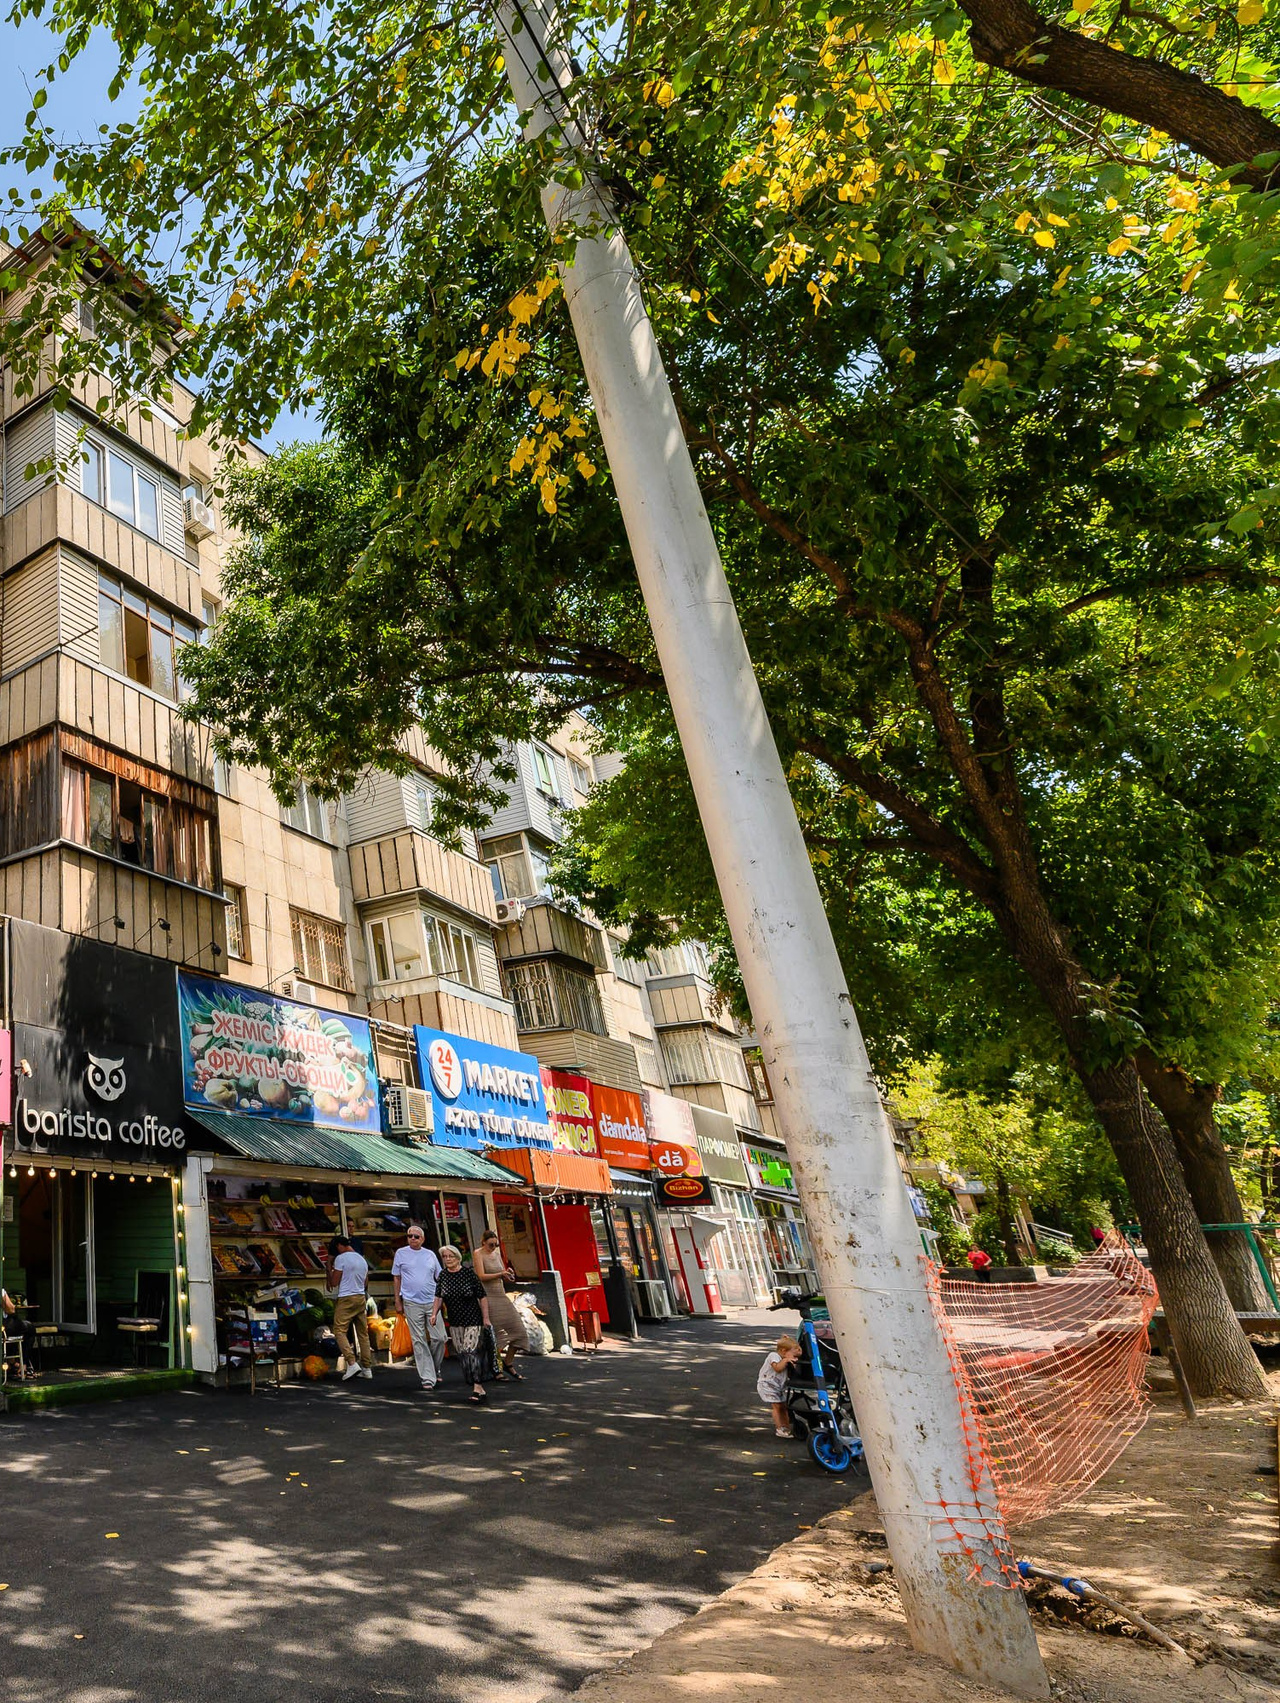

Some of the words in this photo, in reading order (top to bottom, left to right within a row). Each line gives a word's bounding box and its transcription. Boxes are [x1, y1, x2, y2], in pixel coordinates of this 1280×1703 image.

[207, 1049, 346, 1093] ФРУКТЫ-ОВОЩИ
[437, 1047, 452, 1065] 24
[444, 1073, 451, 1089] 7
[462, 1059, 539, 1102] MARKET
[23, 1099, 112, 1141] barista
[119, 1115, 186, 1149] coffee
